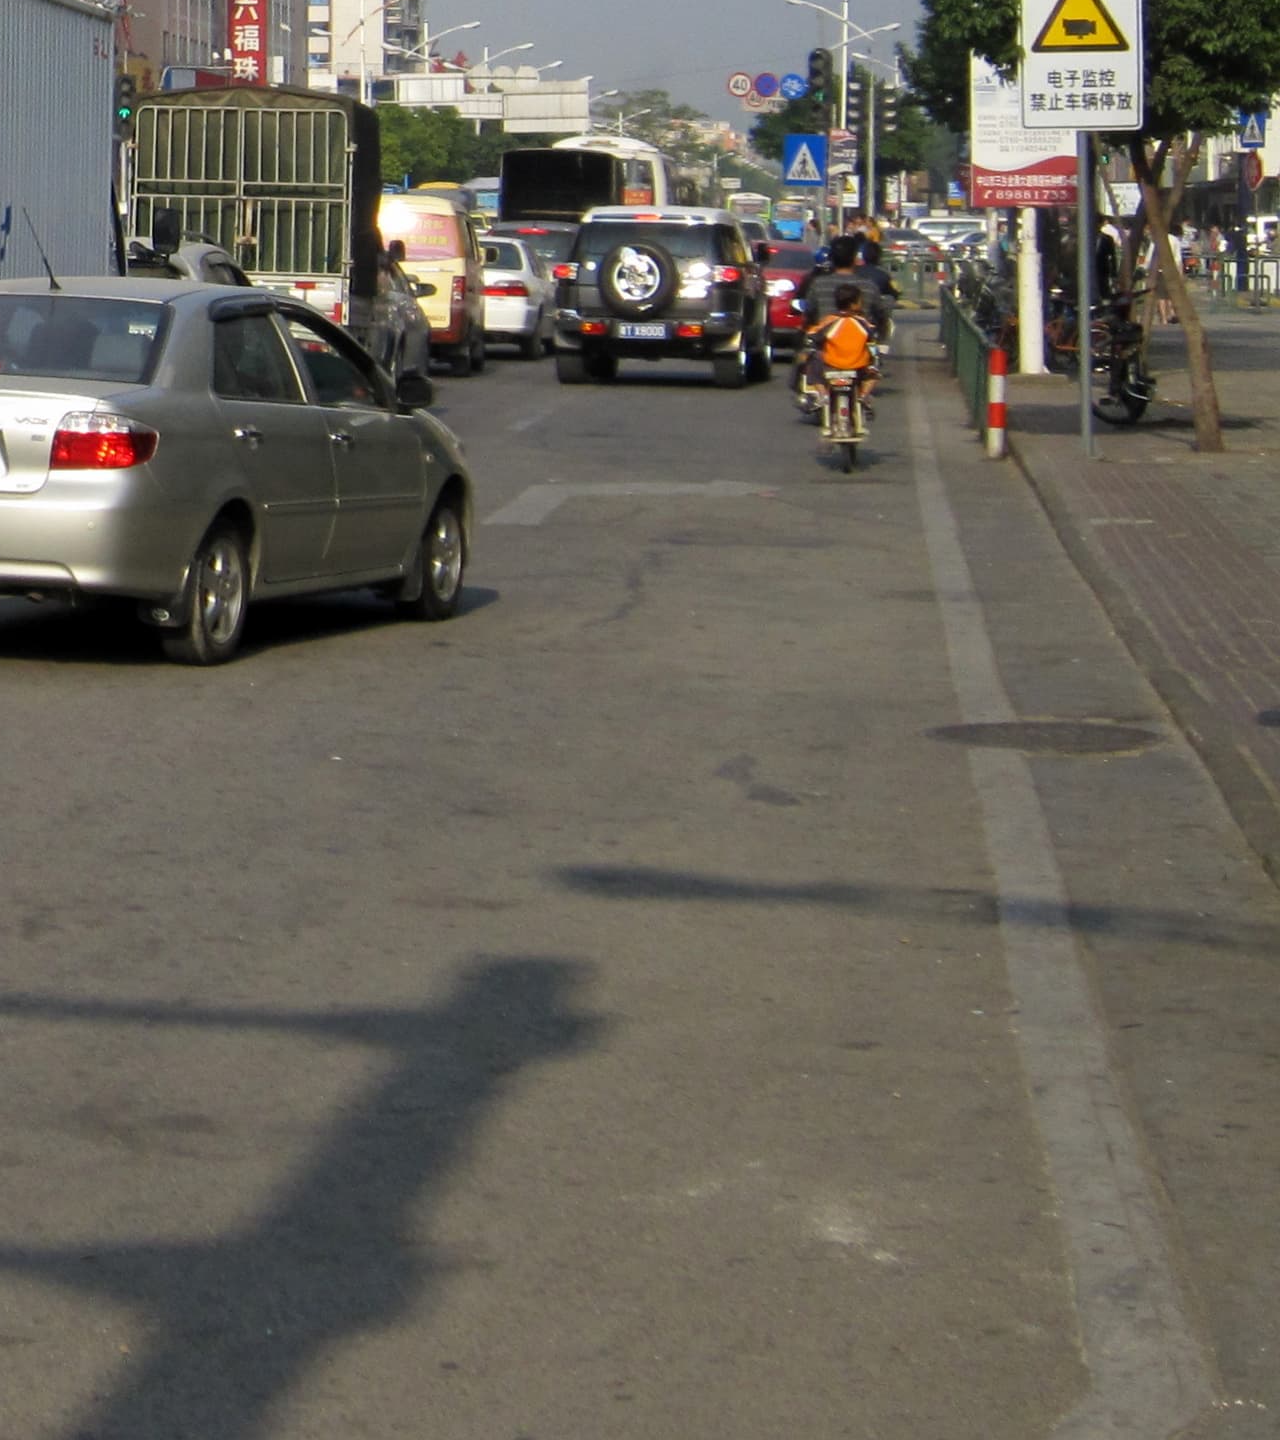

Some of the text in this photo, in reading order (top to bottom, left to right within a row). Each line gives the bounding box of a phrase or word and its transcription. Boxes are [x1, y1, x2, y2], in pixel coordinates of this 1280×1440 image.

[732, 80, 747, 90] 40
[1047, 70, 1115, 88] 电子监控
[1030, 93, 1133, 111] 禁止车辆停放
